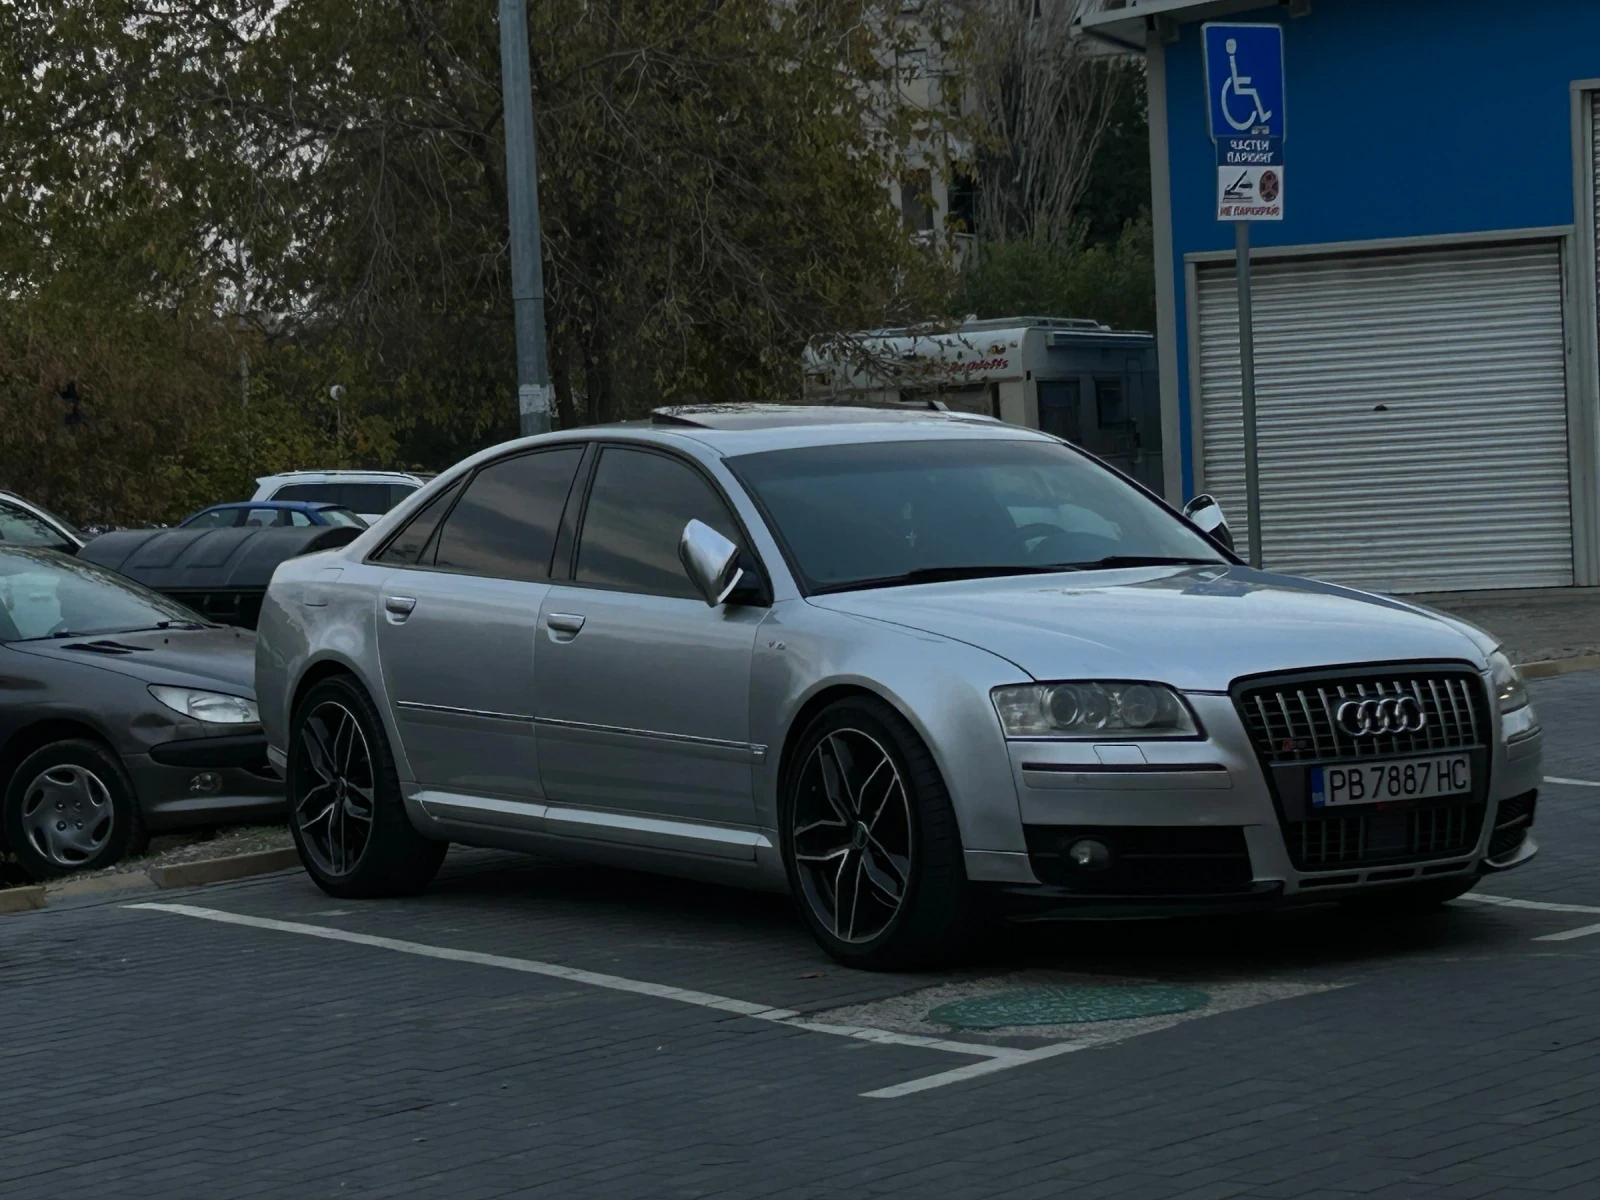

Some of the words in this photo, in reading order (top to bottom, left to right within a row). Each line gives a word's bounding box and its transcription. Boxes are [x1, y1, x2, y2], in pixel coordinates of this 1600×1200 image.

[1329, 768, 1365, 802] PB
[1370, 762, 1431, 799] 7887
[1437, 759, 1466, 792] HC
